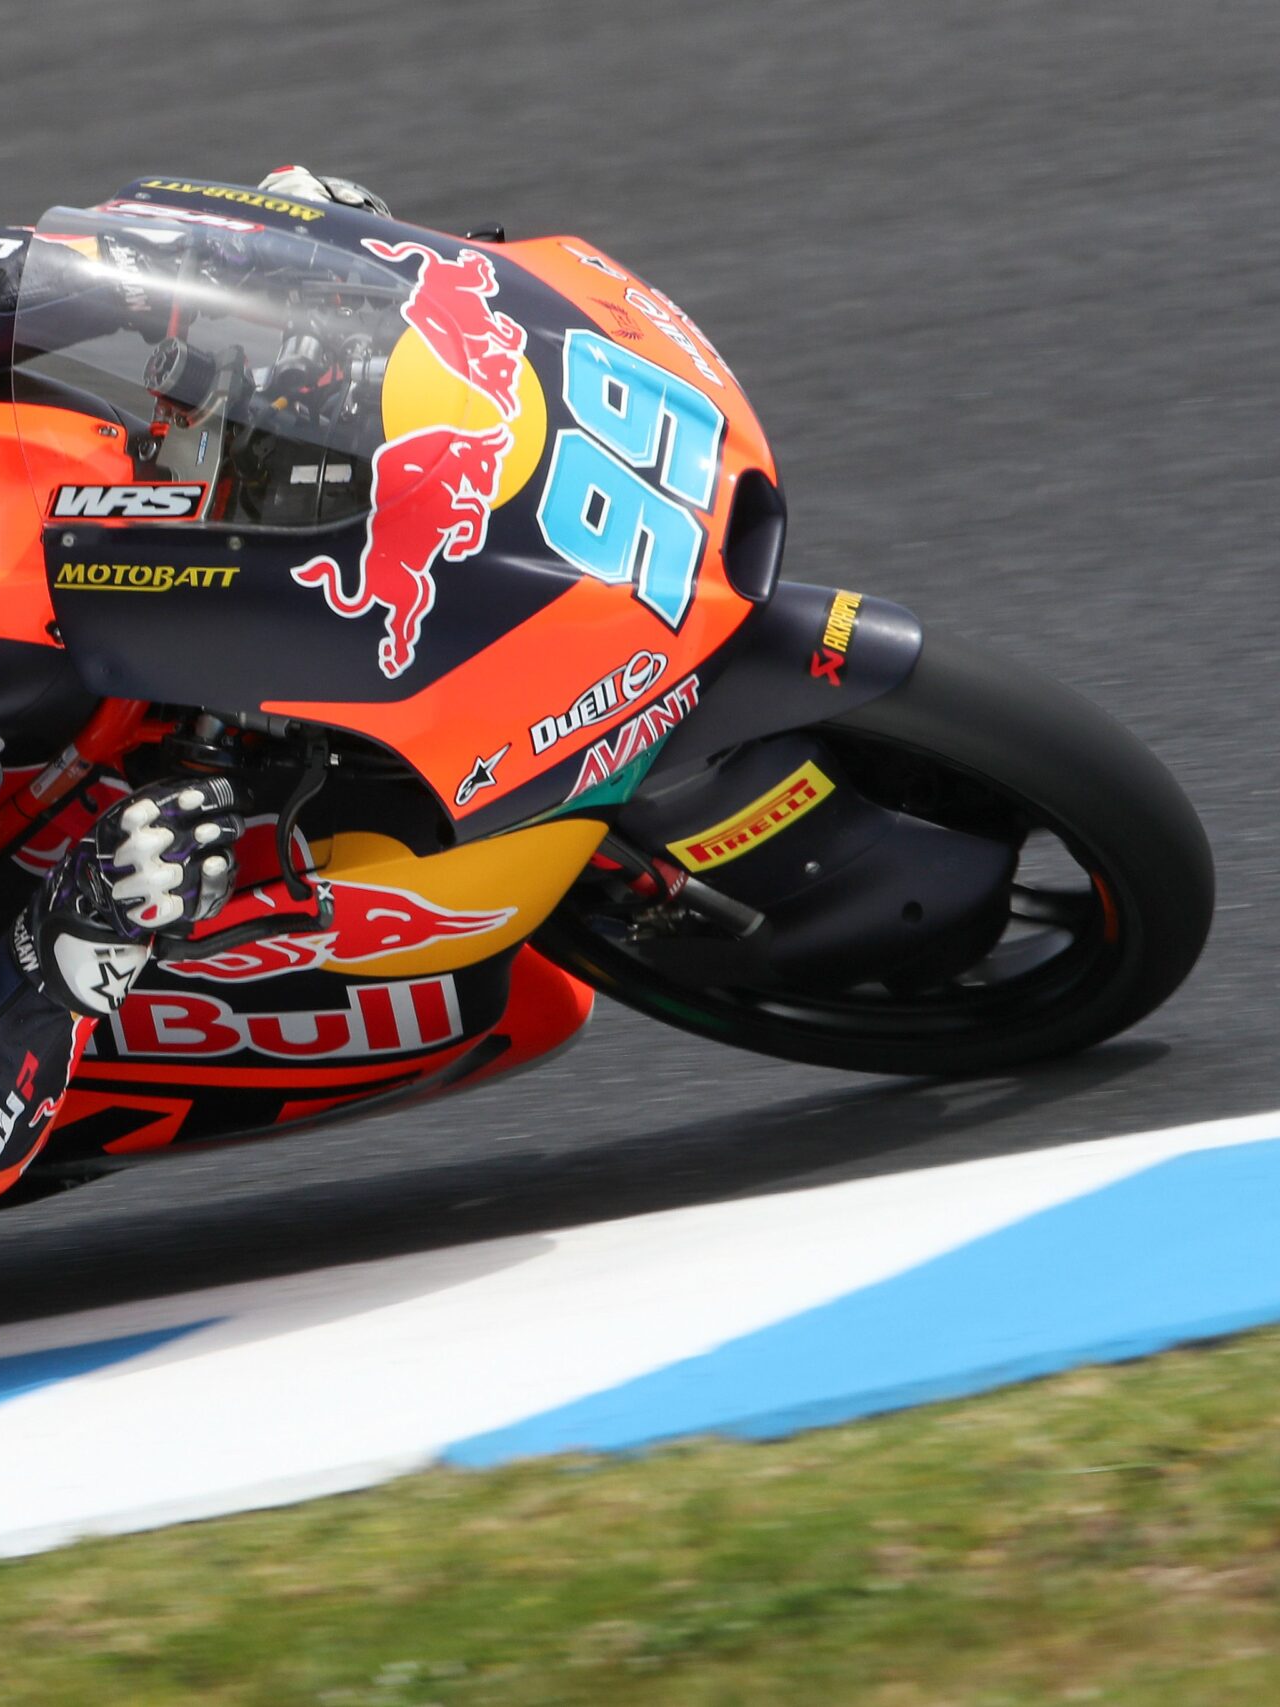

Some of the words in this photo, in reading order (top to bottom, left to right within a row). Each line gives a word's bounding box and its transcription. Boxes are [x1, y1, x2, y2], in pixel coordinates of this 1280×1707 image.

[54, 486, 202, 516] WRS
[536, 328, 725, 629] 99
[54, 563, 241, 593] MOTOBATT
[562, 673, 701, 804] AVANT
[685, 778, 817, 863] PIRELLI
[112, 974, 464, 1058] Bull
